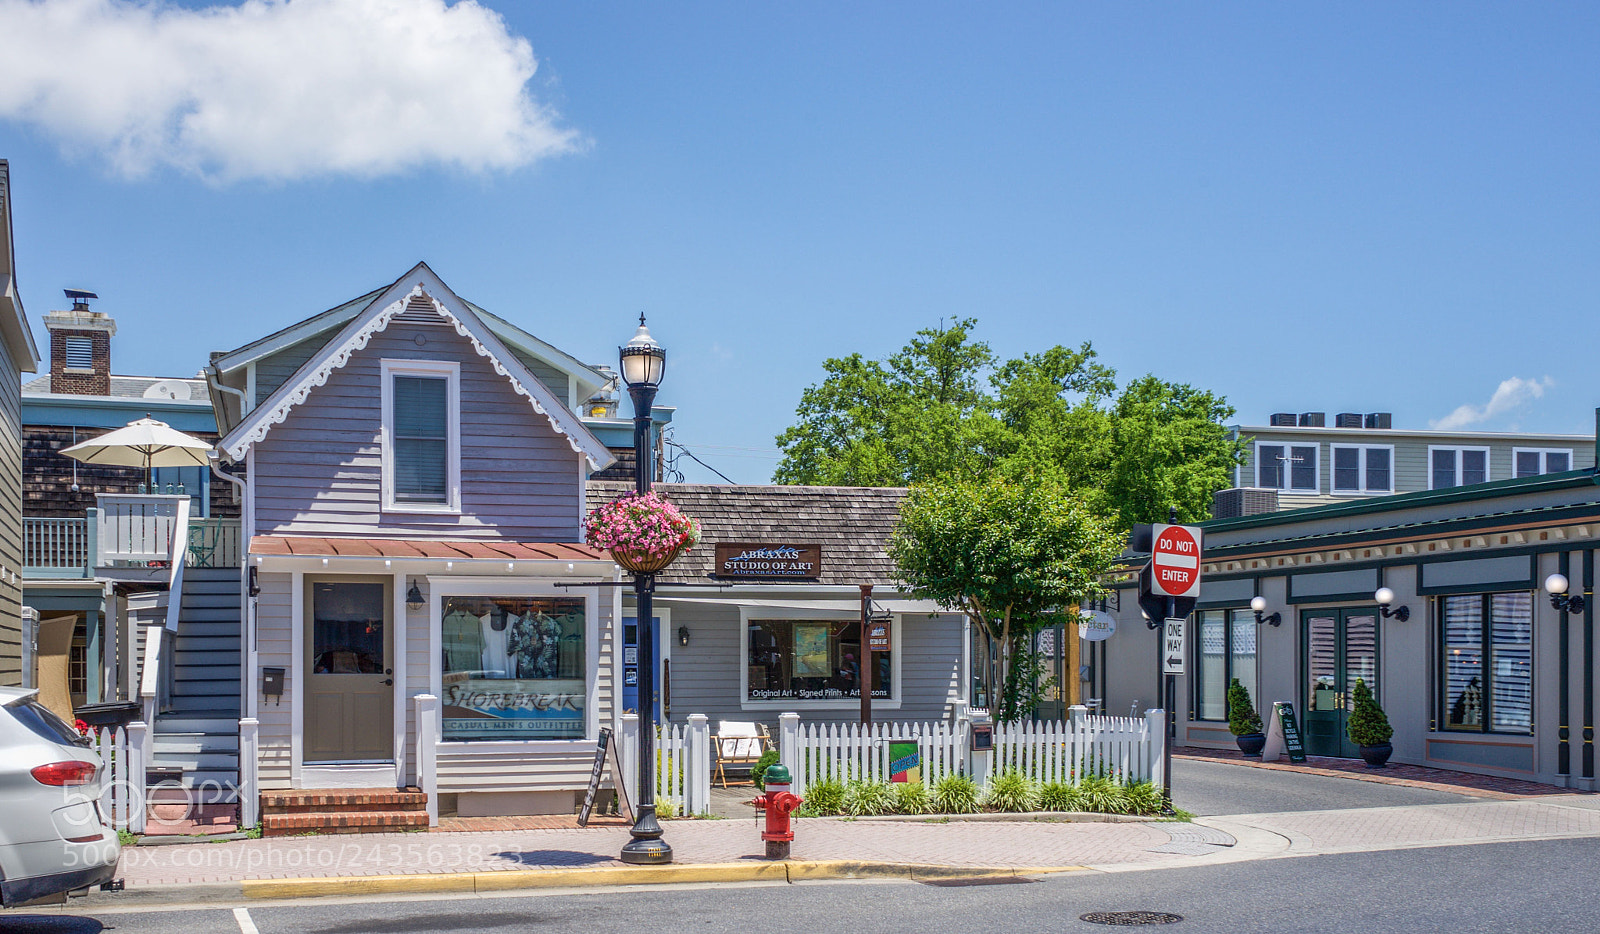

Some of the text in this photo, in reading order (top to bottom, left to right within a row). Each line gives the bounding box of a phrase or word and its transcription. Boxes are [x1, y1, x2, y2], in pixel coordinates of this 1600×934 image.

[1160, 538, 1194, 553] DO NOT
[740, 550, 799, 560] ABRAXAS
[724, 561, 814, 570] STUDIO OF ART
[1162, 569, 1189, 583] ENTER
[1080, 620, 1109, 630] ectar
[1167, 624, 1182, 637] ONE
[1167, 640, 1182, 652] WAY
[445, 685, 583, 711] SHOREBREAK
[752, 689, 781, 698] Original
[782, 689, 792, 697] Art
[799, 689, 824, 698] Signed
[825, 689, 843, 697] Prints
[850, 689, 860, 697] Art
[893, 757, 918, 771] OPEN
